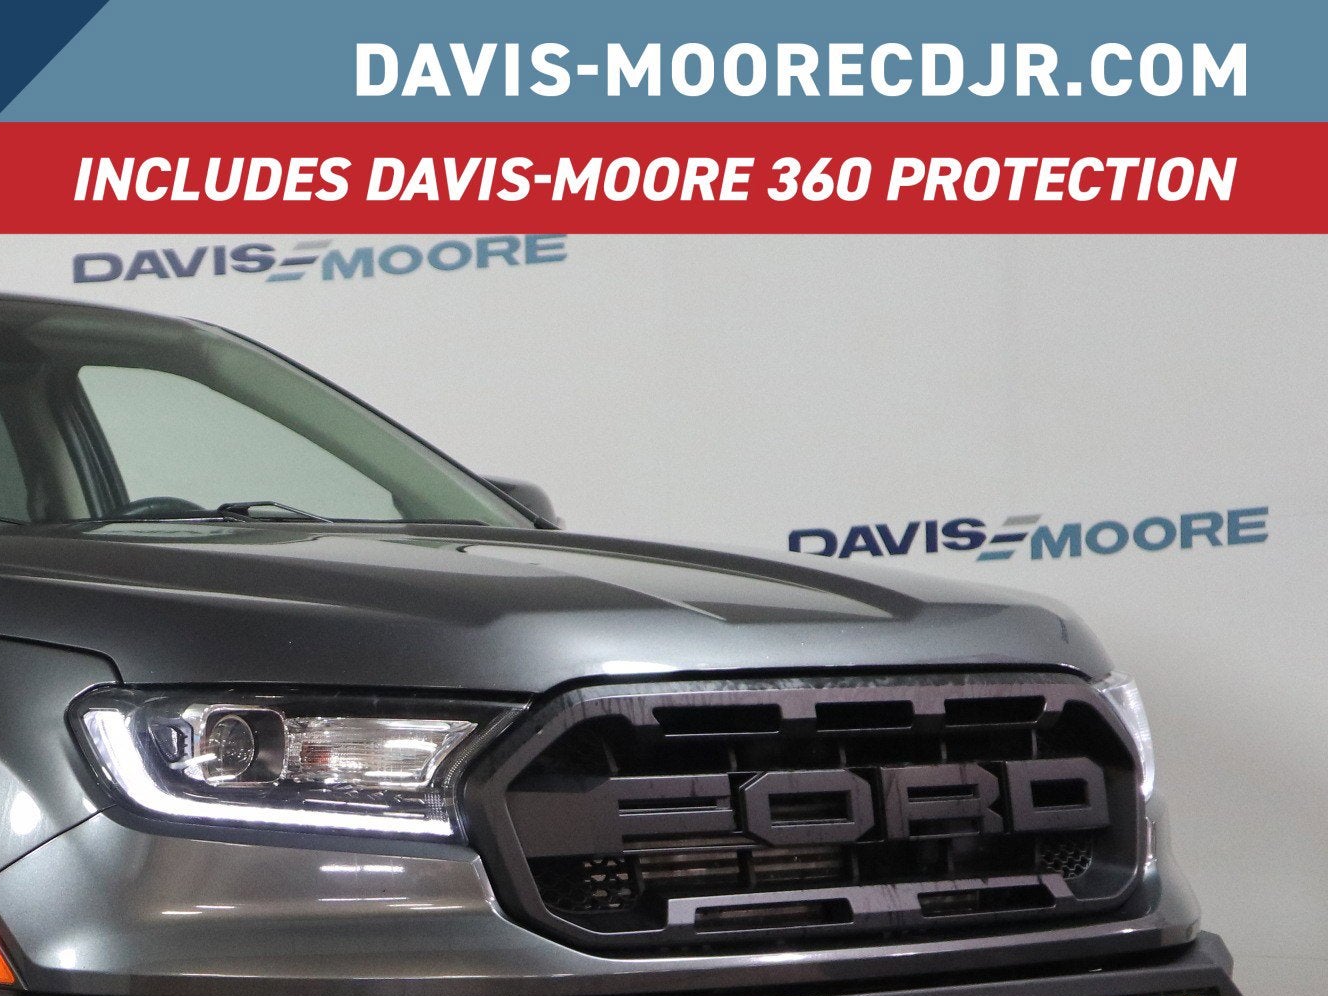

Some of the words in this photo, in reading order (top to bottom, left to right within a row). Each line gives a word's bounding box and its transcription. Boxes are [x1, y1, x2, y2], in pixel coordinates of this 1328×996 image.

[72, 243, 276, 284] DAVIS
[321, 233, 569, 281] MOORE
[1030, 505, 1270, 561] MOORE
[562, 757, 1112, 857] FORD
